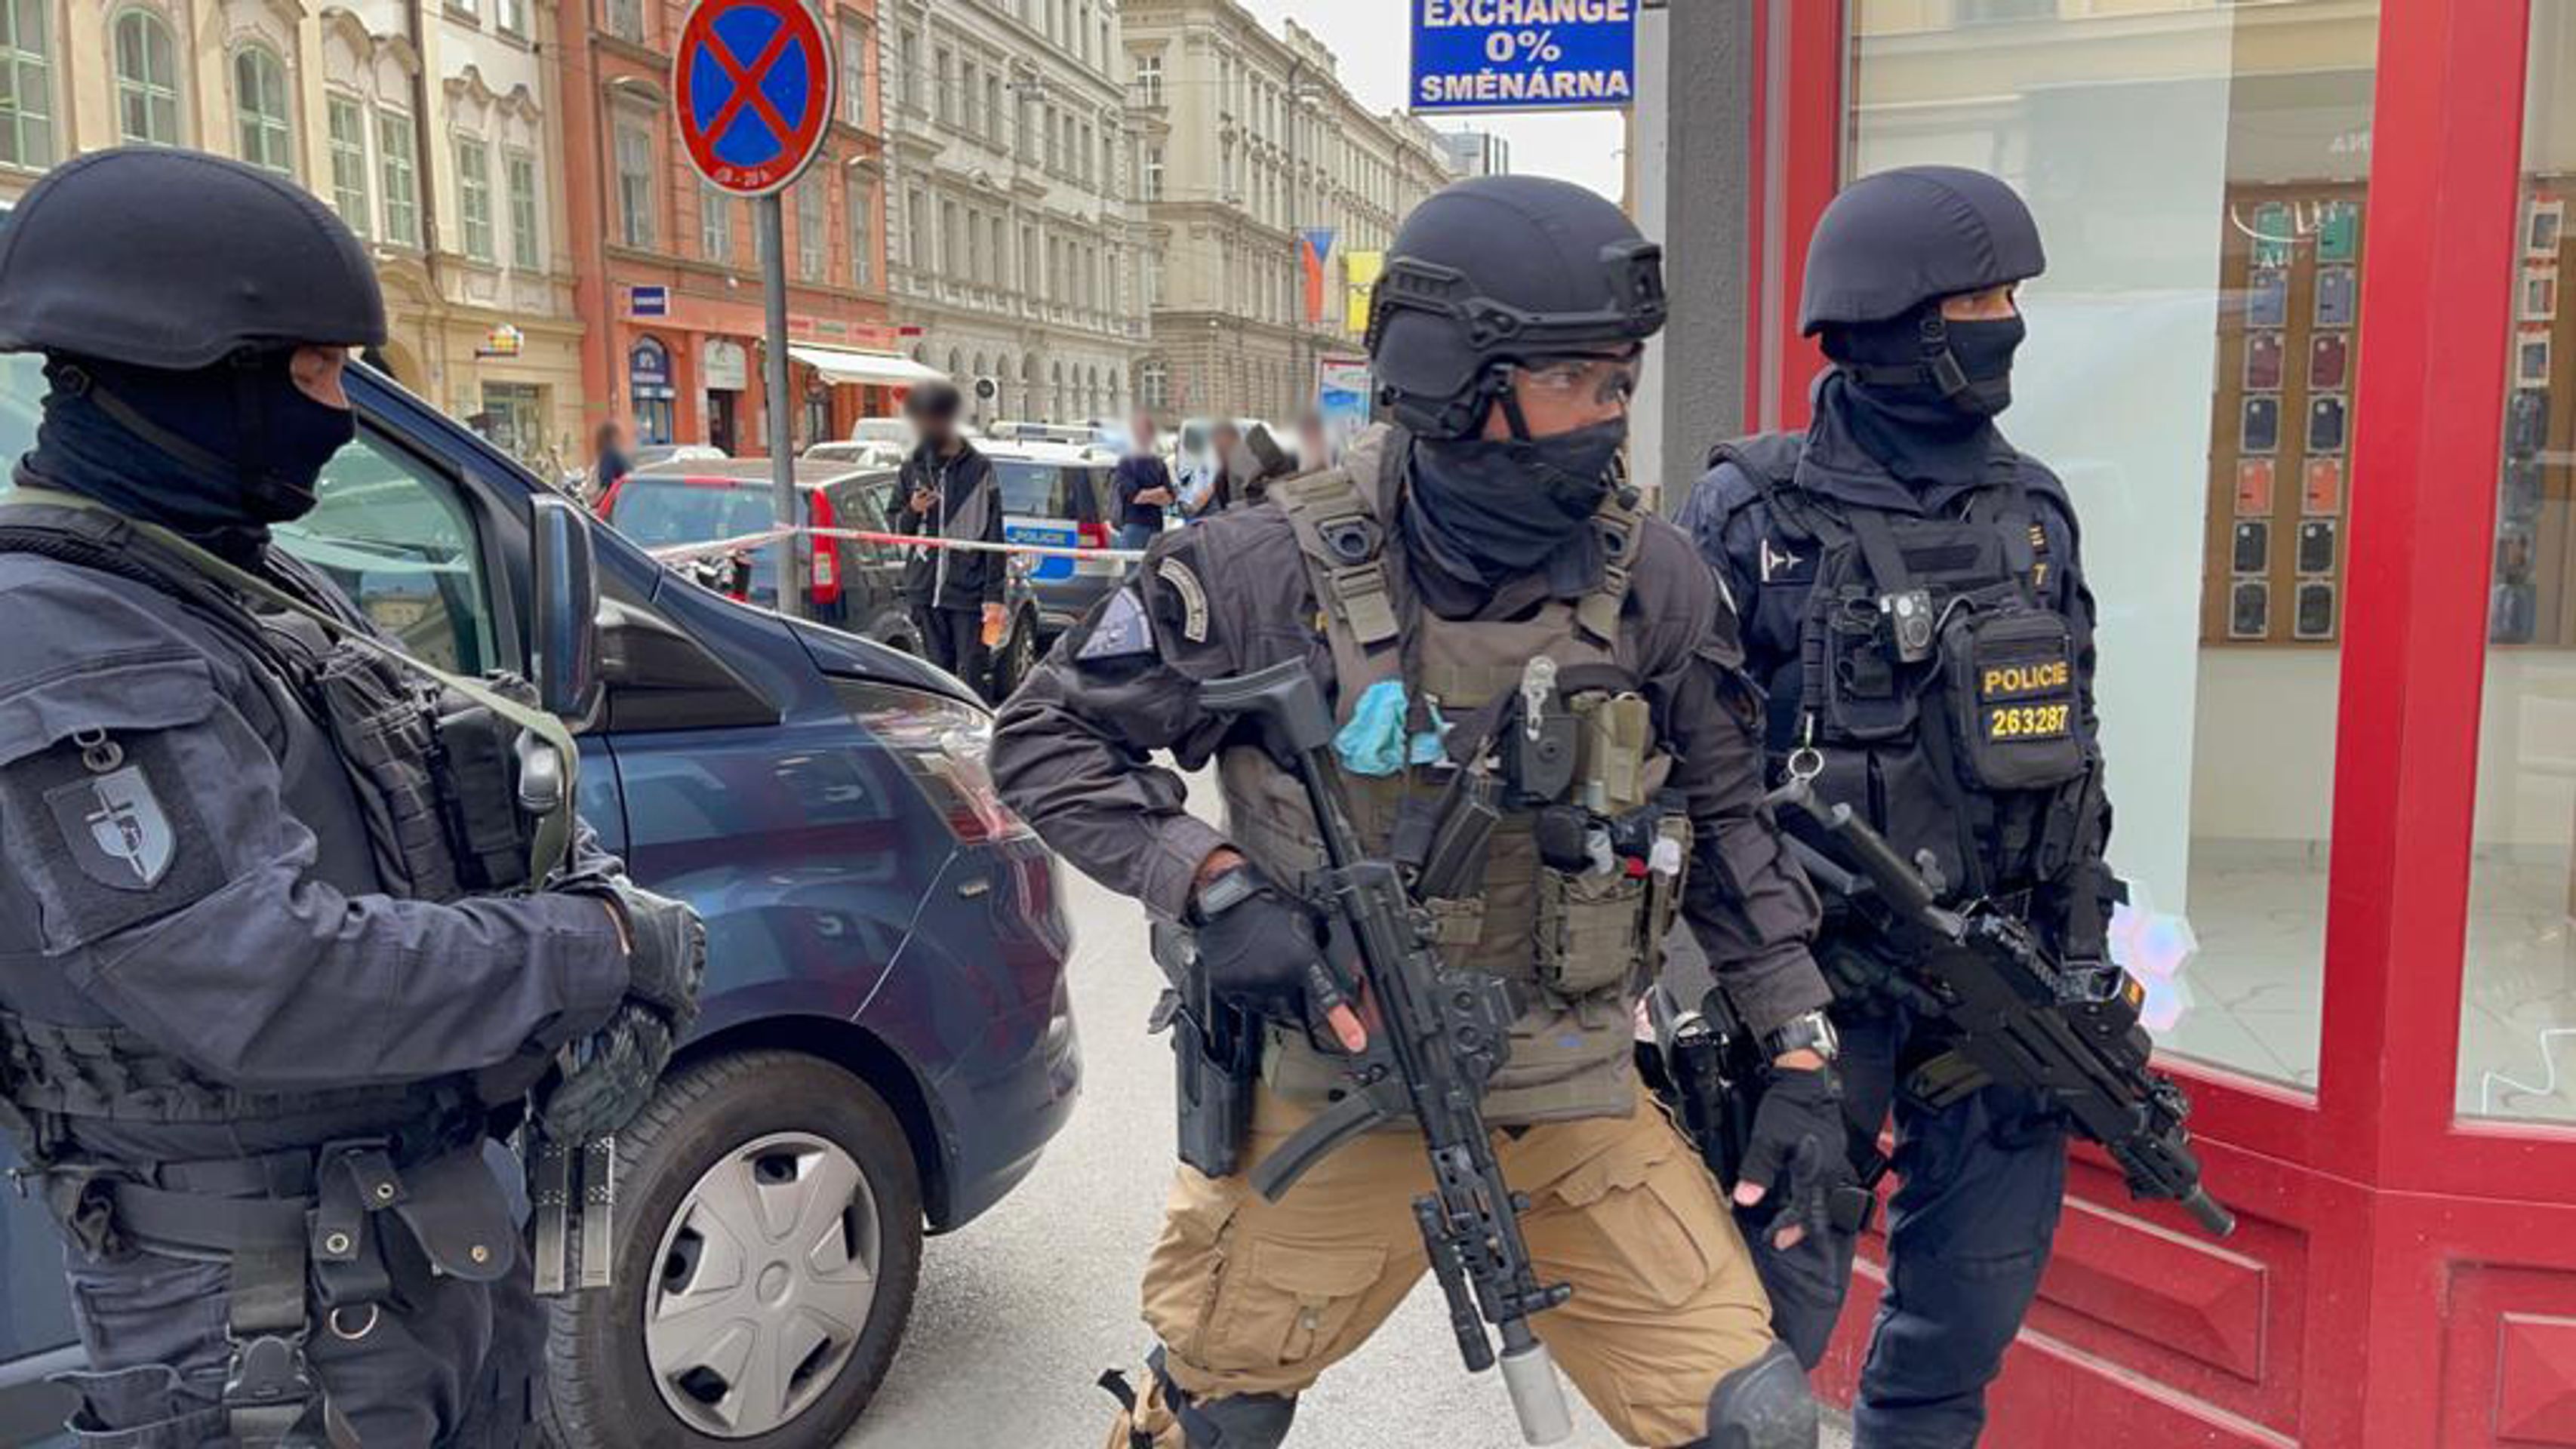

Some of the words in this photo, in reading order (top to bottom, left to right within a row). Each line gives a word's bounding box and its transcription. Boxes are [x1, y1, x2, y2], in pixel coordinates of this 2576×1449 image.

[1423, 0, 1630, 26] EXCHANGE
[1485, 30, 1561, 62] 0%
[1420, 66, 1630, 101] SMĚNÁRNA
[1993, 705, 2069, 735] 263287
